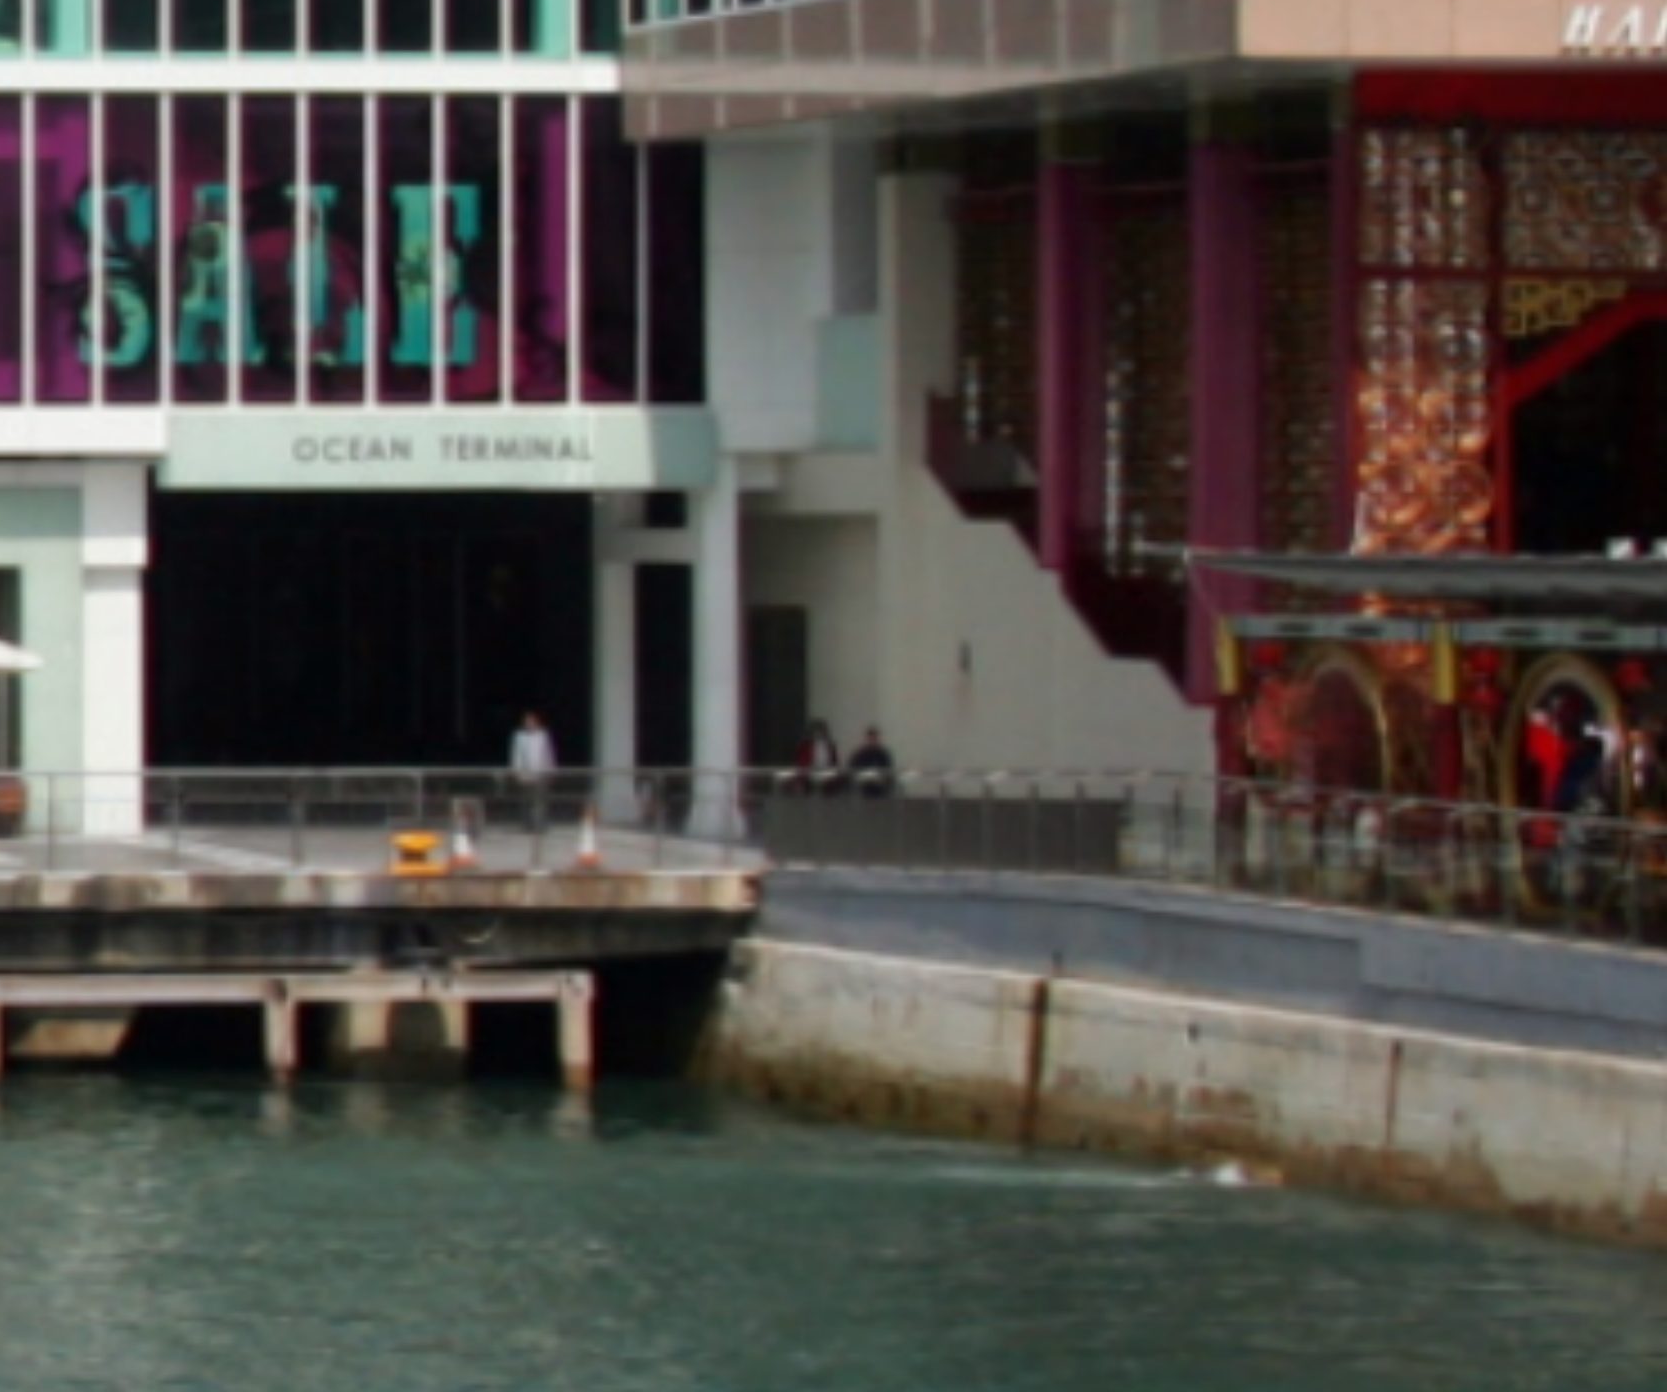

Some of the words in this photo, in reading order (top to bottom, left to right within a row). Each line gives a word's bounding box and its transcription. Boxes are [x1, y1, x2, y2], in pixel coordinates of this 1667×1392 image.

[77, 182, 482, 367] SALE
[292, 436, 413, 463] OCEAN
[439, 436, 592, 462] TERMINAL
